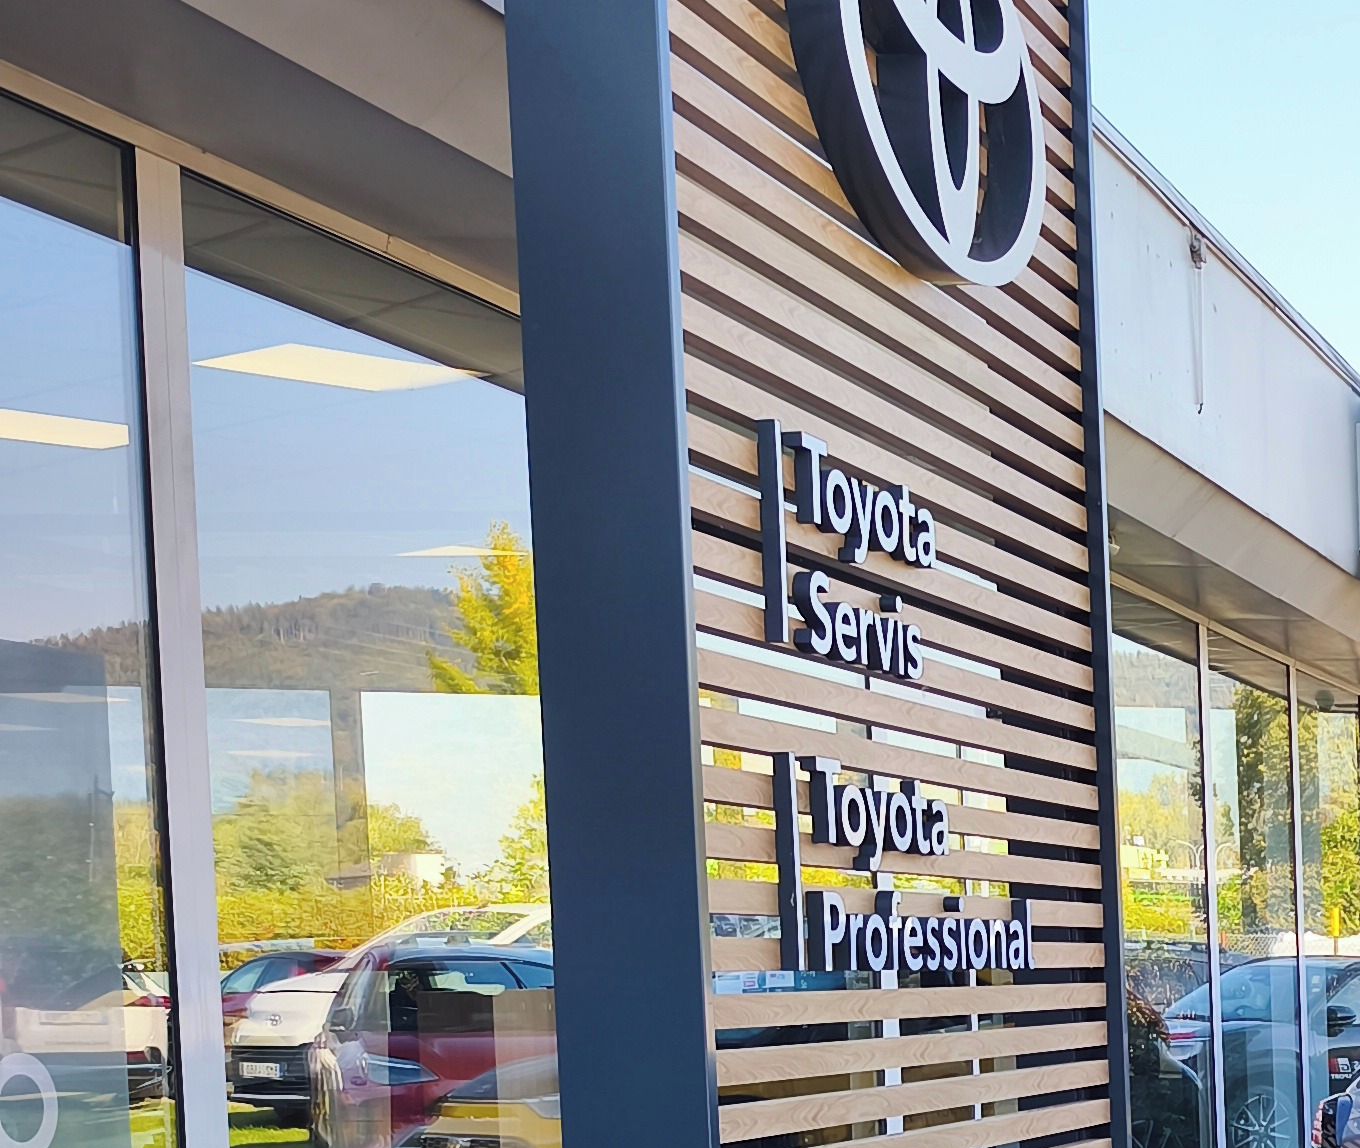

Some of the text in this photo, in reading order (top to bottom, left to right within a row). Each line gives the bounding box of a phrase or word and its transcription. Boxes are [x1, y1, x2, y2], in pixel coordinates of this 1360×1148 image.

[797, 432, 938, 569] Toyota
[807, 570, 924, 681] Servis
[813, 757, 950, 872] Toyota
[822, 890, 1036, 973] Professional
